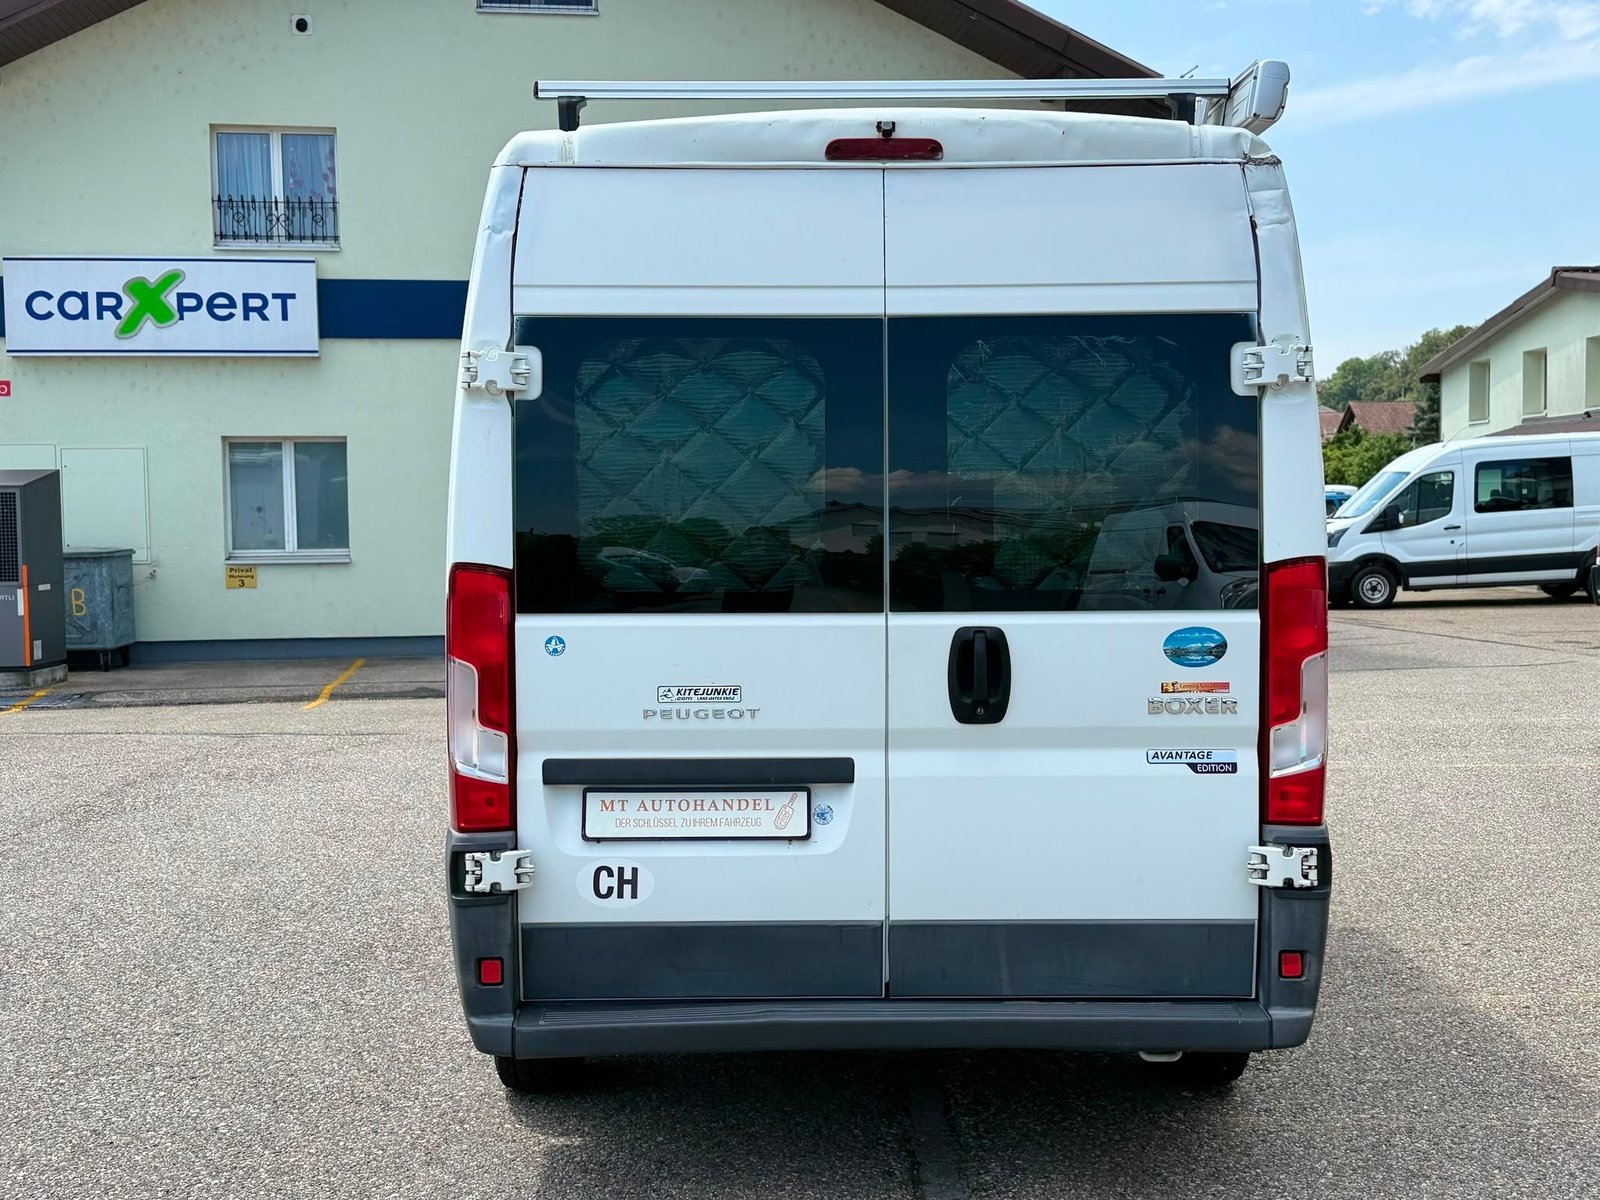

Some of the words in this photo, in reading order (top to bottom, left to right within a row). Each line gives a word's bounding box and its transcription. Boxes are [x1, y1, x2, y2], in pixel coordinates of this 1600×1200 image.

[238, 578, 245, 588] 3
[71, 588, 87, 616] B
[676, 688, 740, 696] KITEJUNKIE
[1147, 696, 1238, 715] BOXER
[642, 707, 761, 720] PEUGEOT
[1151, 750, 1213, 760] AVANTAGE
[1197, 763, 1232, 773] EDITION
[600, 799, 629, 812] MT
[636, 798, 775, 812] AUTOHANDEL
[615, 818, 632, 828] DER
[633, 816, 678, 828] SCHLÜSSEL
[680, 818, 693, 828] ZU
[693, 817, 718, 828] IHREM
[719, 817, 762, 828] FAHRZEUG
[593, 865, 638, 900] CH
